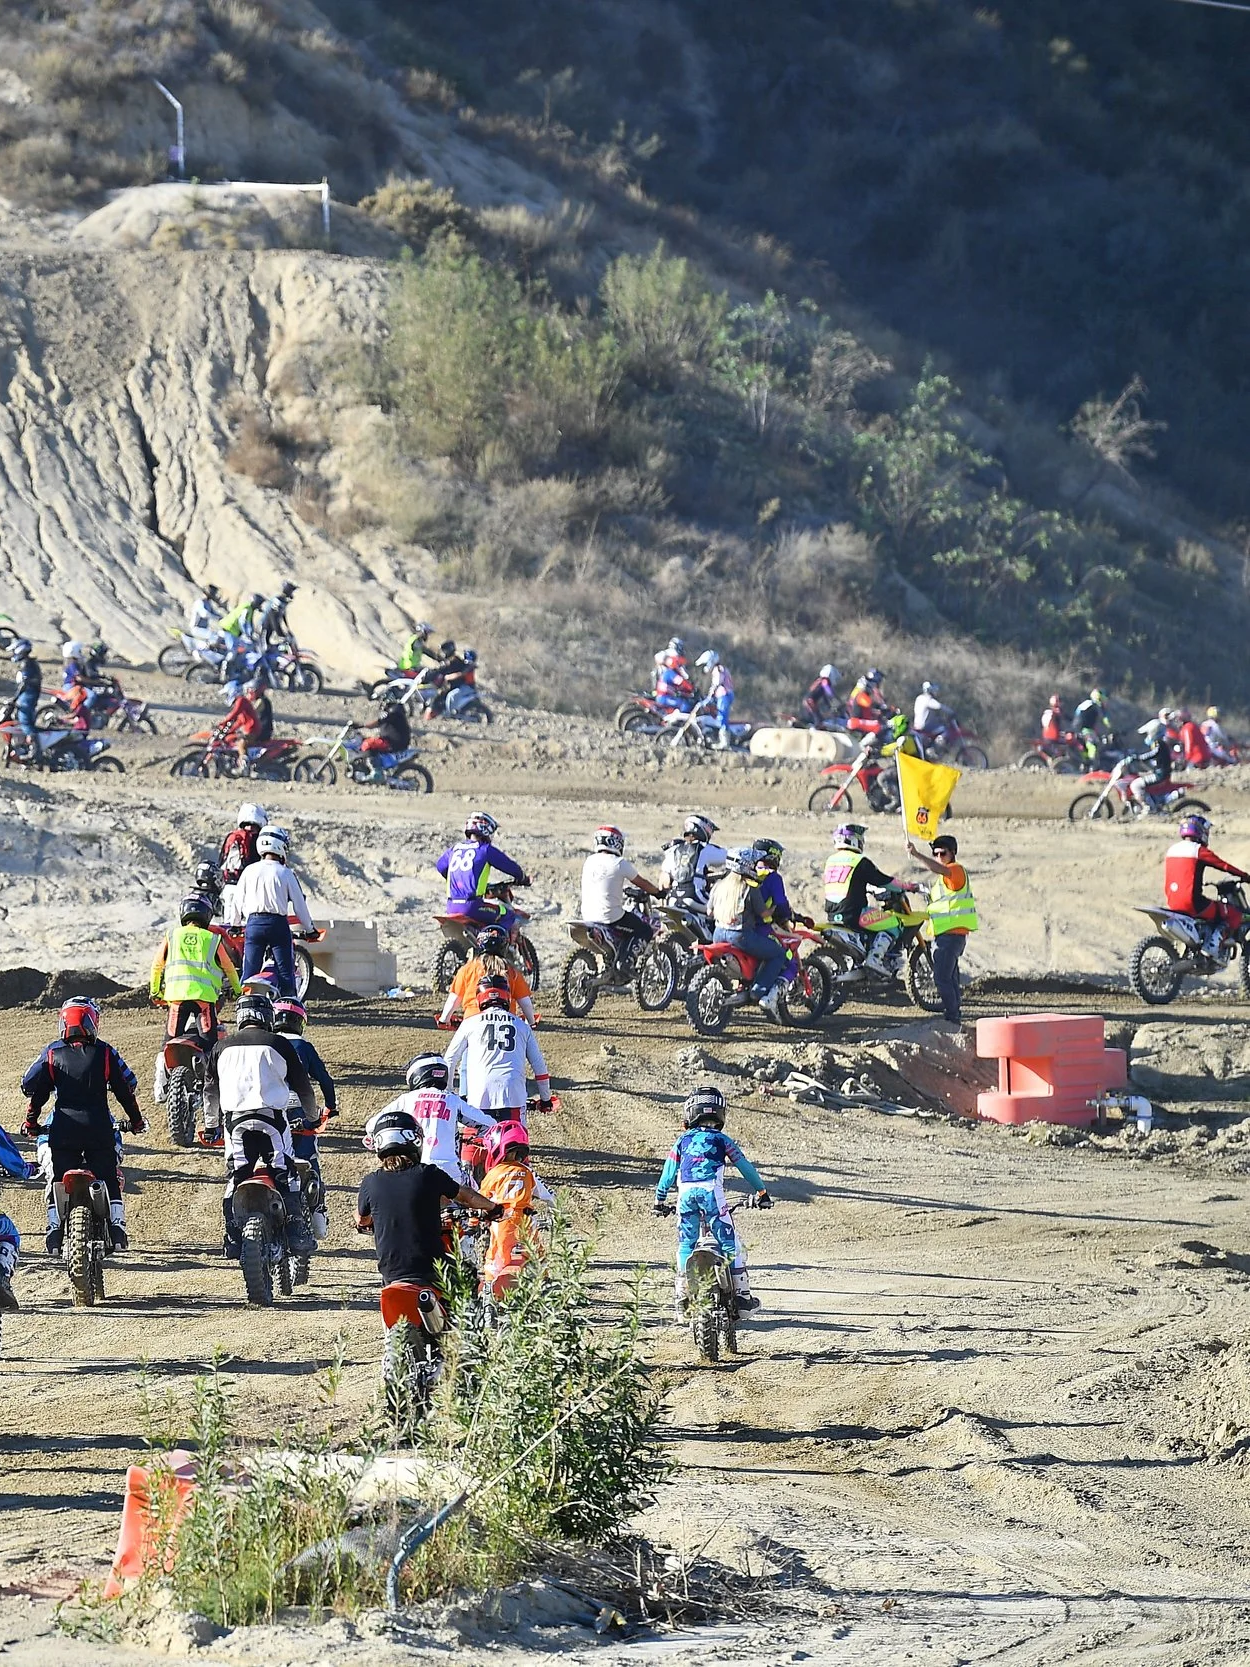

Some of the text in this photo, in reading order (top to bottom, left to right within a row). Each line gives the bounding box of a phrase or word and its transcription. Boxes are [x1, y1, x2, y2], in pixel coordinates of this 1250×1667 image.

[449, 848, 476, 872] 68
[184, 935, 198, 945] 66
[481, 1023, 517, 1052] 43
